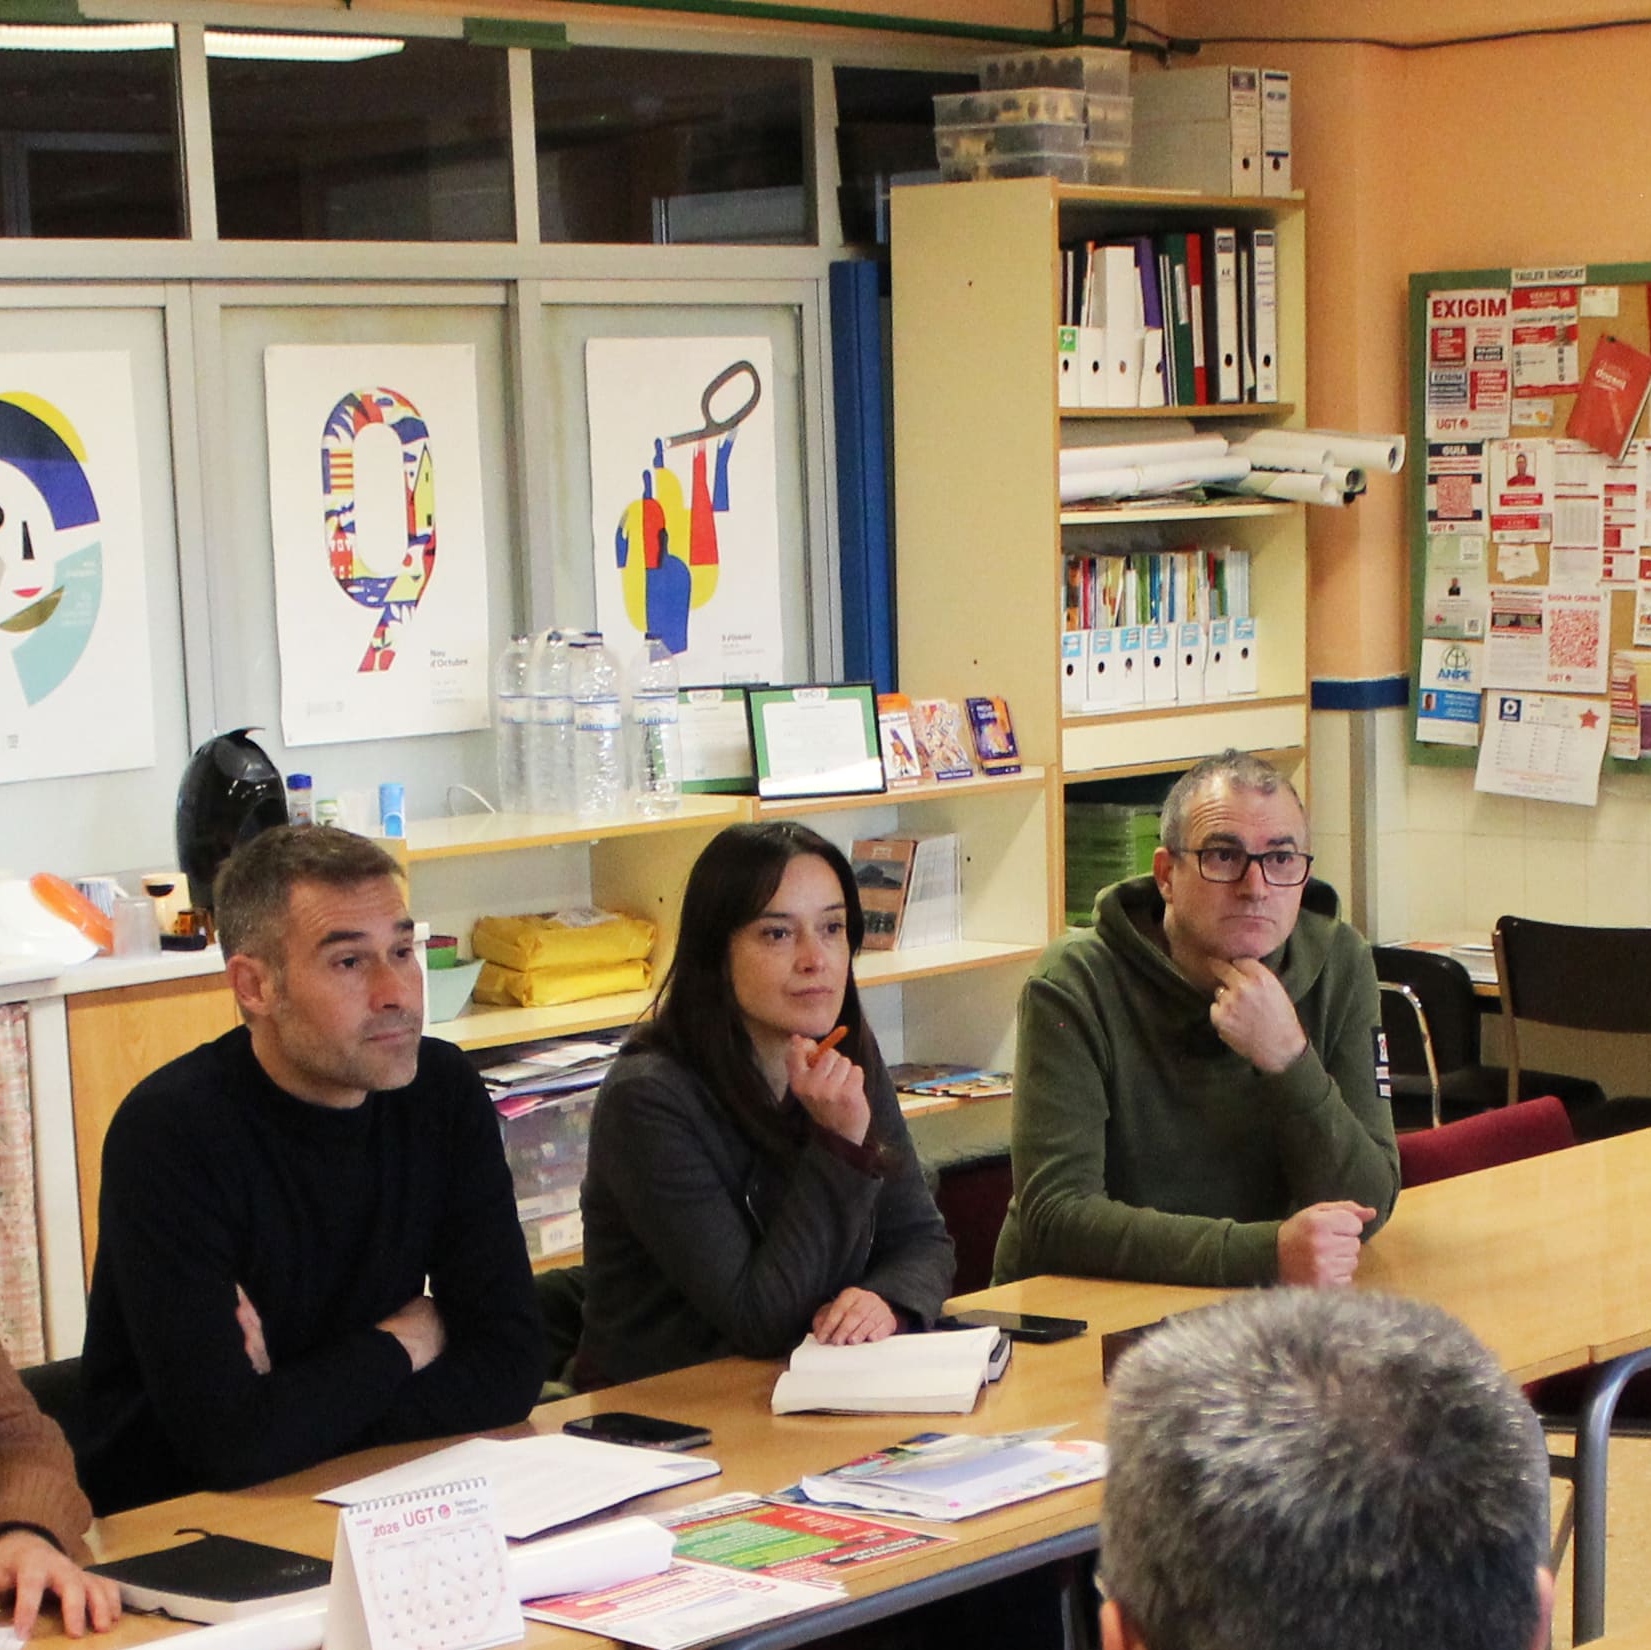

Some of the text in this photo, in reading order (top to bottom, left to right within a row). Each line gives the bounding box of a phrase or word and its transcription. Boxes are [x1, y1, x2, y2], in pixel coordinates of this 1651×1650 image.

[1432, 299, 1506, 318] EXIGIM
[1436, 418, 1457, 430] UGT
[1438, 668, 1471, 682] ANPE
[373, 1506, 435, 1538] 2026 UGT
